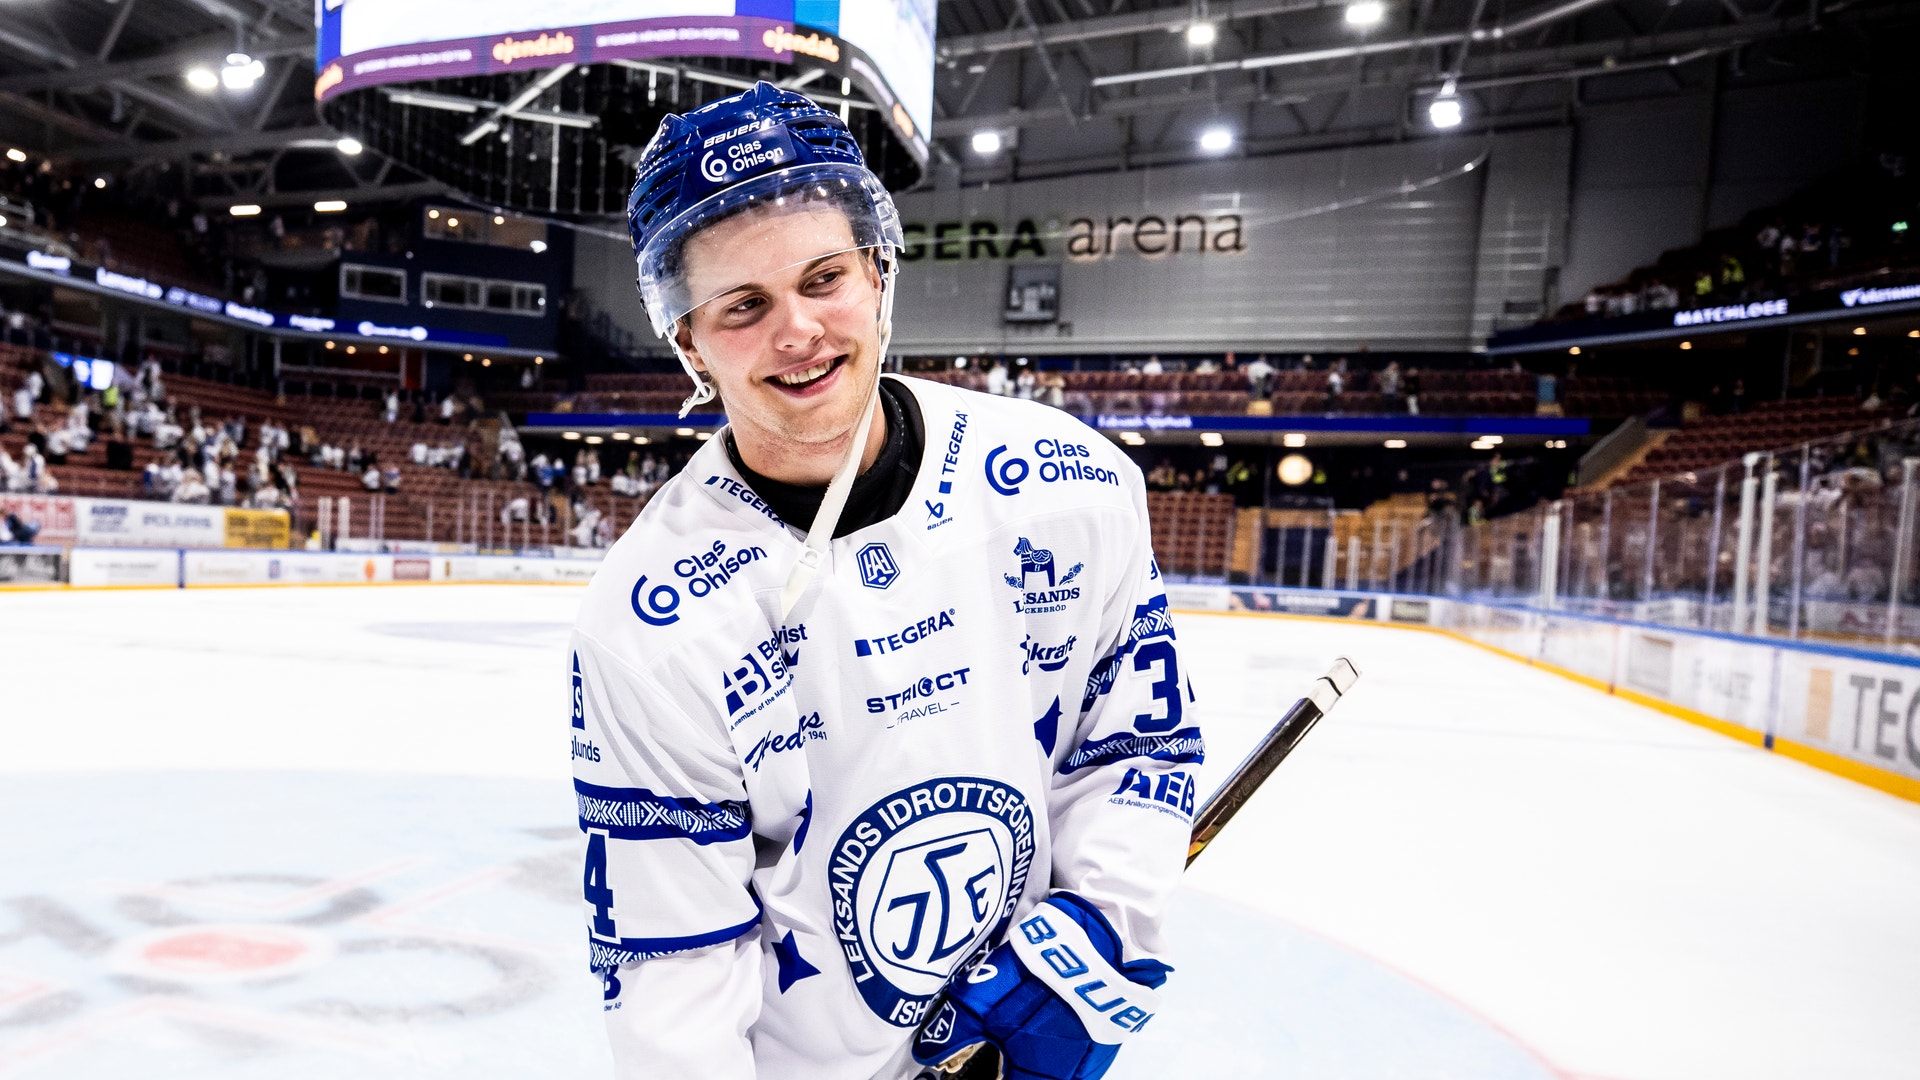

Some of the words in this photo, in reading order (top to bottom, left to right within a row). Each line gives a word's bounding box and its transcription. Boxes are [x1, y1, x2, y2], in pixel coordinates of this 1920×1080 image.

[493, 31, 574, 64] ejendals
[763, 25, 840, 63] ejendals
[703, 121, 760, 149] BAUER
[728, 140, 762, 159] Clas
[732, 147, 784, 172] Ohlson
[896, 218, 1046, 262] GERA
[1067, 213, 1247, 256] arena
[941, 412, 968, 475] TEGERA
[1034, 439, 1090, 458] Clas
[1039, 460, 1119, 486] Ohlson
[719, 477, 786, 529] TEGERA
[927, 517, 953, 530] BAUER
[674, 540, 726, 578] Clas
[688, 546, 768, 598] Ohlson
[1013, 587, 1080, 613] LSANDS
[1025, 604, 1067, 614] CKEBRÖD
[1027, 635, 1077, 661] kraft
[1133, 640, 1195, 734] 3
[734, 708, 757, 727] member
[757, 702, 765, 711] of
[765, 696, 775, 706] the
[808, 730, 827, 741] 1941
[1108, 797, 1124, 805] AEB
[1111, 767, 1195, 818] AEB
[877, 782, 1034, 917] IDROTTSFÖRENING
[832, 822, 882, 984] LEKSANDS
